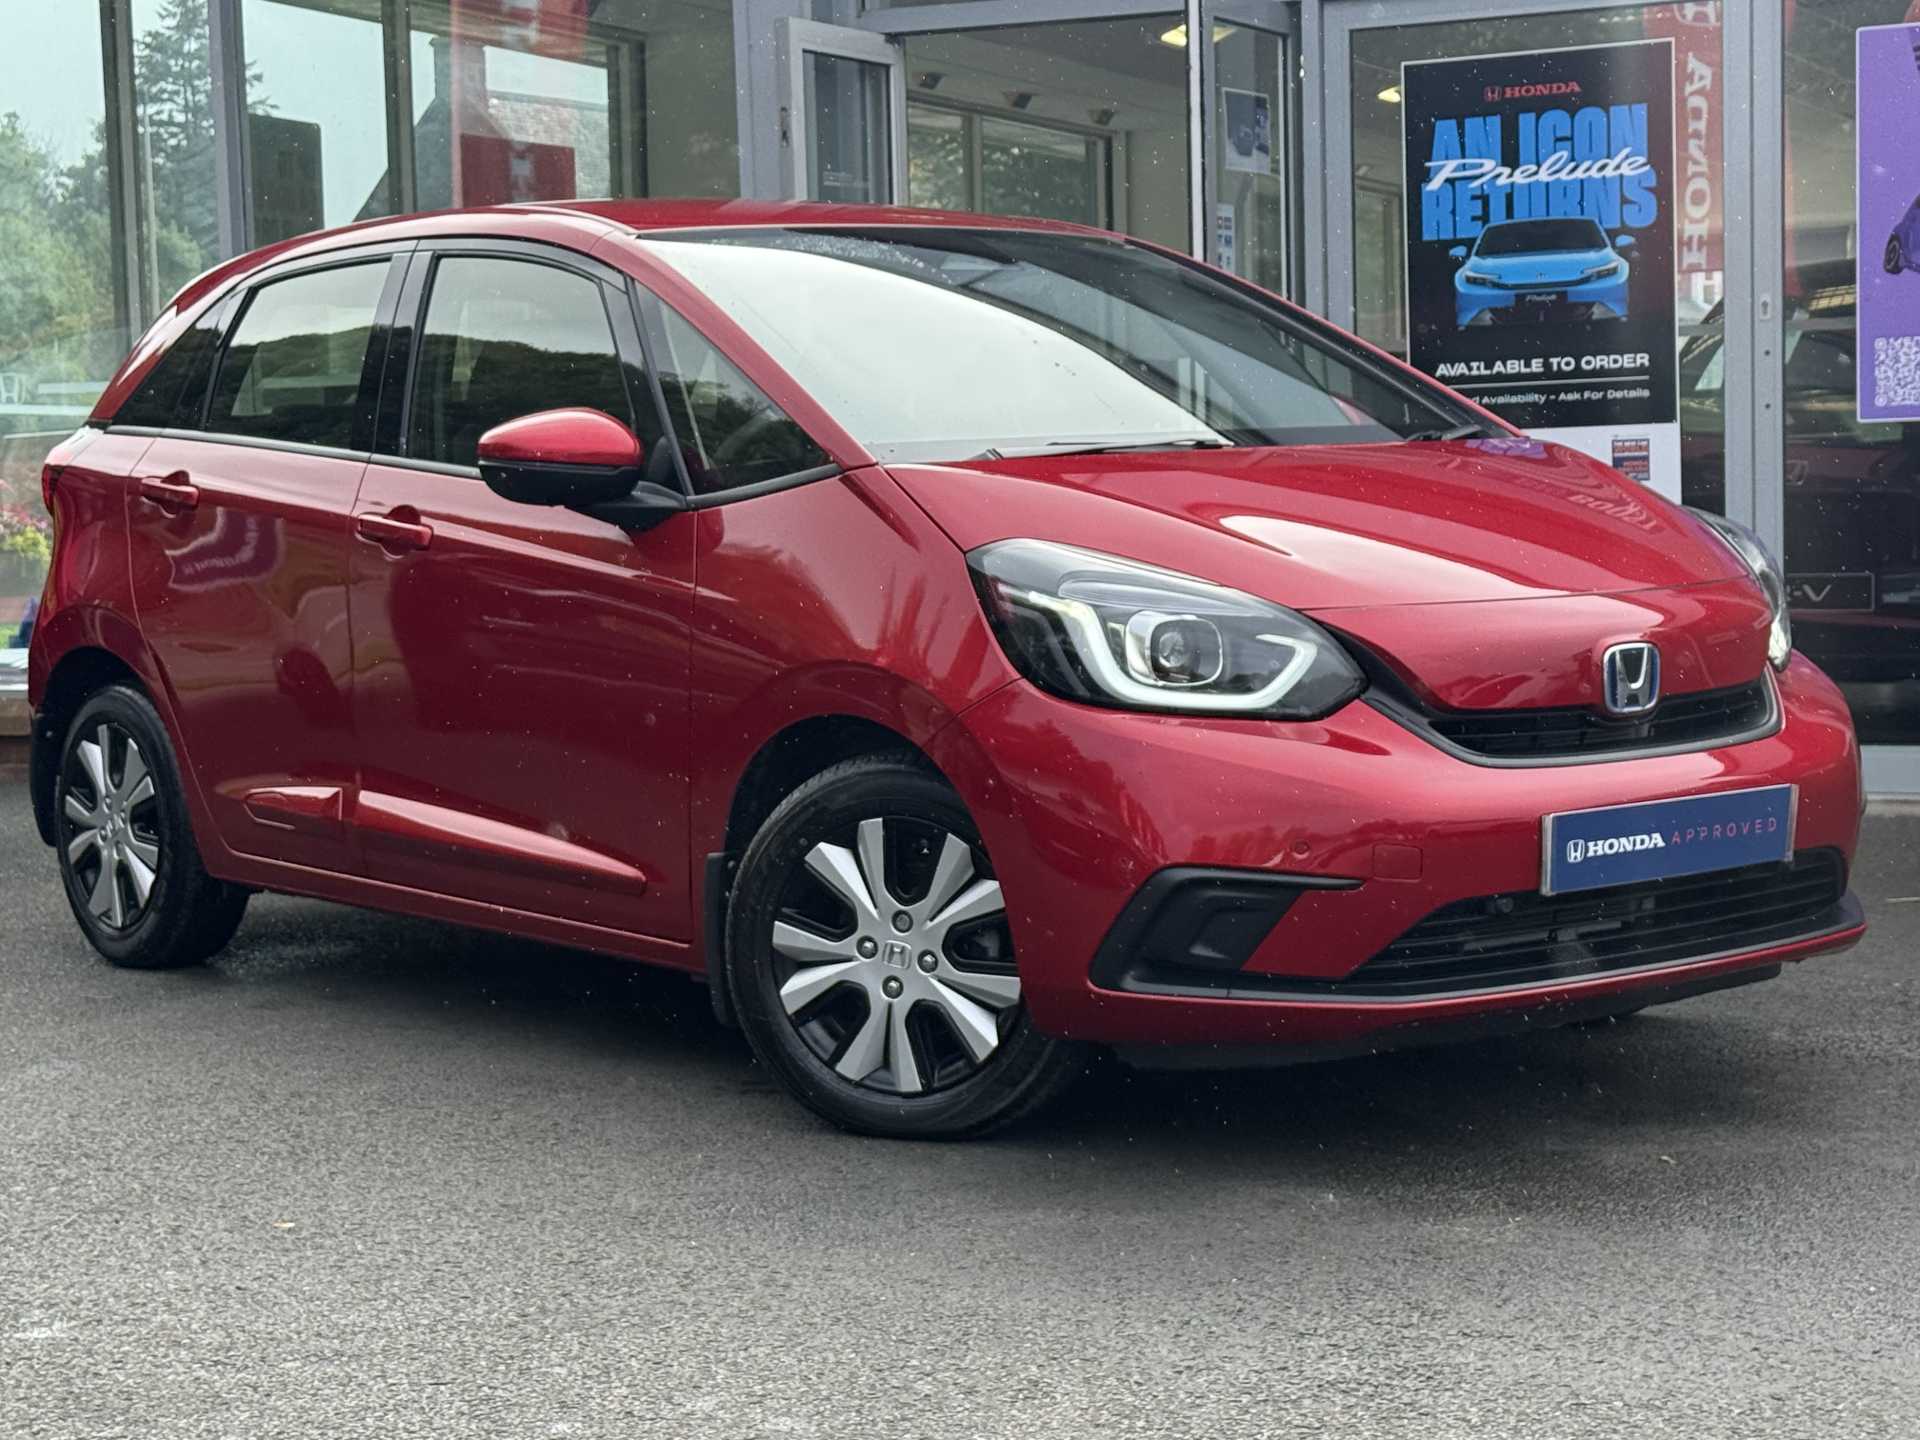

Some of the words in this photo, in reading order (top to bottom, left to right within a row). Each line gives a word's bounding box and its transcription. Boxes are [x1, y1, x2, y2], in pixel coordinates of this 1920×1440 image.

[1504, 82, 1581, 98] HONDA
[1430, 114, 1501, 178] AN
[1518, 103, 1648, 165] ICON
[1424, 147, 1650, 191] Prelude
[1421, 167, 1657, 241] RETURNS
[1435, 358, 1544, 378] AVAILABLE
[1549, 356, 1576, 371] TO
[1581, 352, 1650, 370] ORDER
[1481, 392, 1547, 405] Availability
[1558, 391, 1581, 402] Ask
[1583, 390, 1604, 400] For
[1606, 387, 1650, 401] Details
[1586, 833, 1666, 857] HONDA
[1671, 817, 1777, 845] APPROVED
